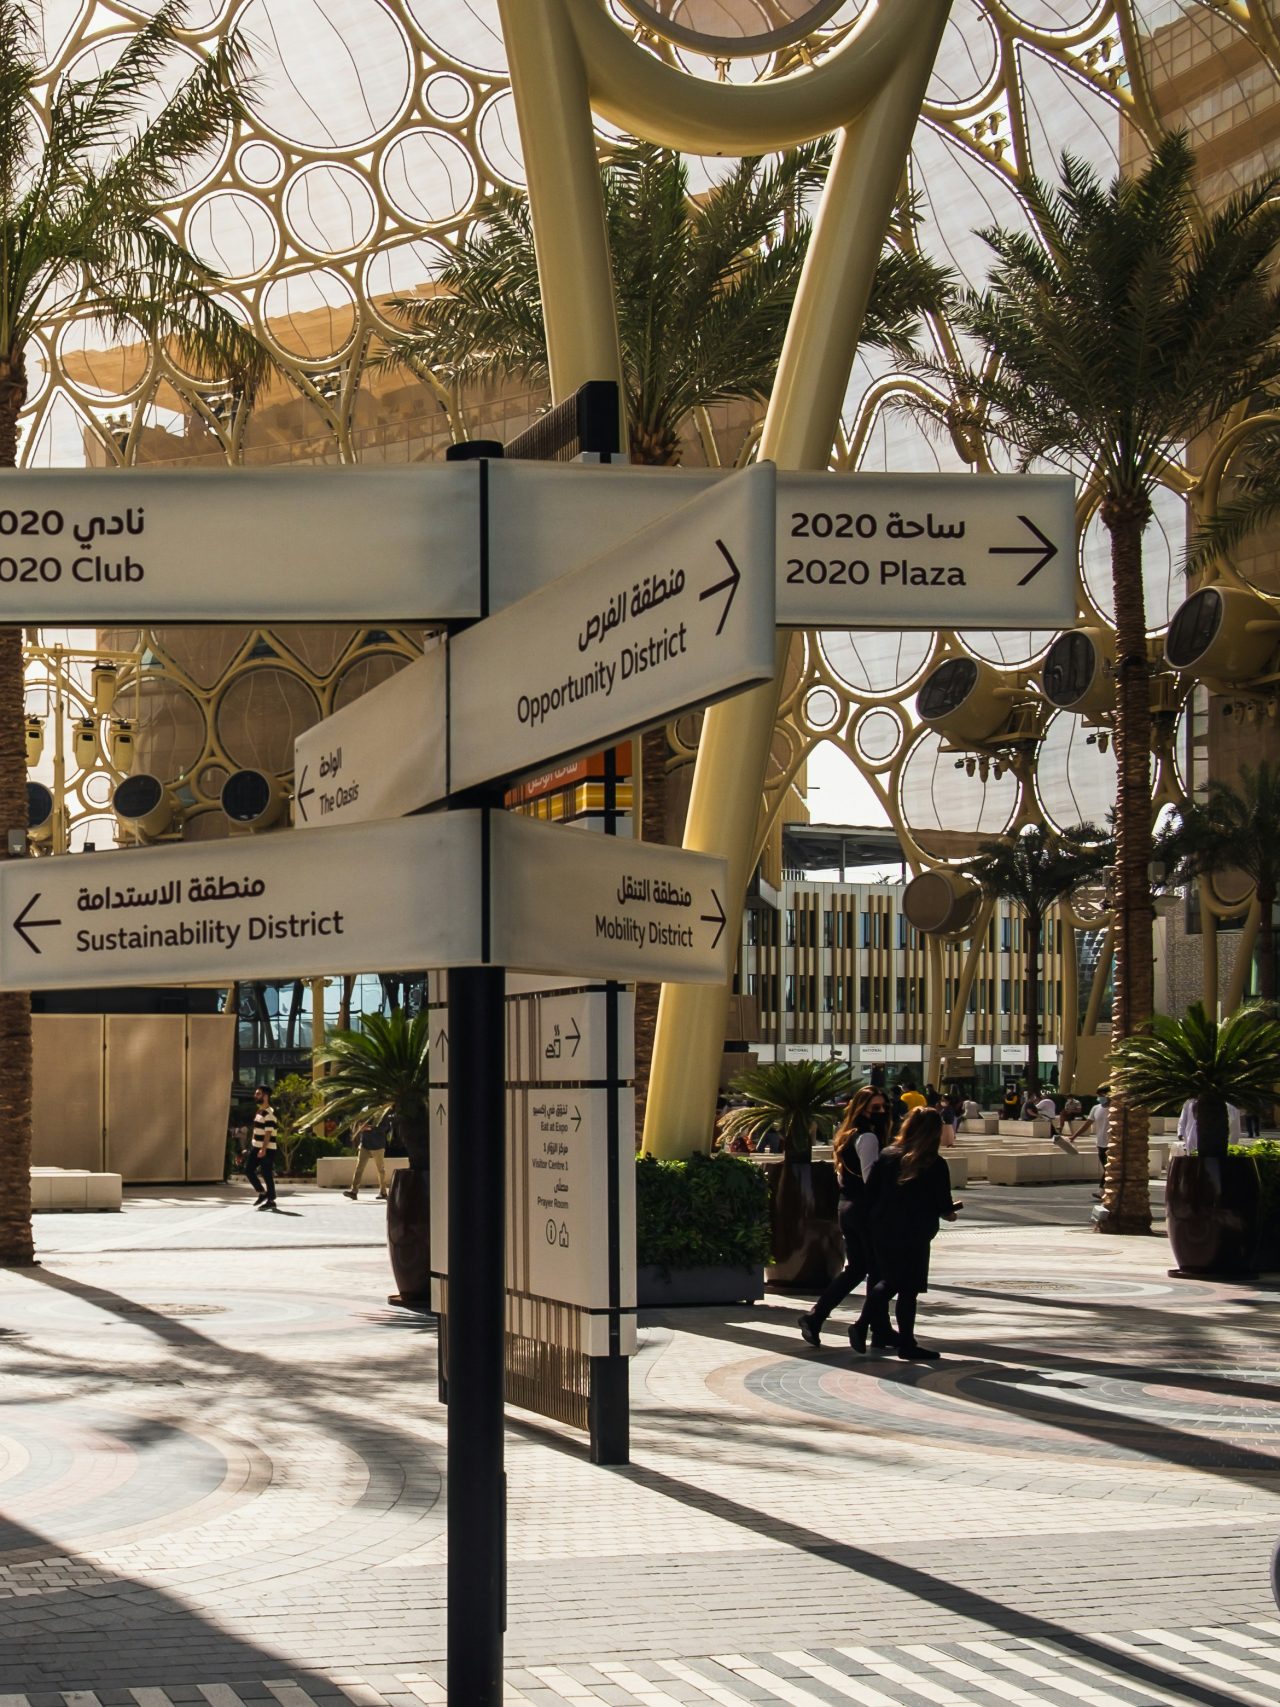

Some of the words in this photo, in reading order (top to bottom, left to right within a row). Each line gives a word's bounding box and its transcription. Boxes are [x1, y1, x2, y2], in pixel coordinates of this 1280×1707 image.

[73, 507, 144, 550] نادي
[791, 512, 877, 538] 2020
[886, 512, 965, 539] ساحة
[72, 555, 145, 582] Club
[786, 559, 870, 585] 2020
[880, 559, 966, 586] Plaza
[630, 569, 686, 618] منطقة
[578, 591, 626, 652] الفرص
[517, 661, 616, 728] Opportunity
[621, 622, 687, 680] District
[320, 747, 342, 778] الواحة
[320, 793, 335, 815] The
[336, 780, 359, 808] Oasis
[77, 880, 182, 911] الاستدامة
[188, 876, 266, 903] منطقة
[617, 875, 651, 905] التنقل
[653, 880, 692, 907] منطقة
[76, 919, 241, 952] Sustainability
[249, 910, 344, 941] District
[595, 914, 646, 949] Mobility
[649, 921, 694, 948] District
[541, 1121, 549, 1131] Eat
[556, 1121, 568, 1134] Expo
[532, 1158, 547, 1169] Visitor
[548, 1160, 564, 1170] Centre
[537, 1196, 553, 1209] Prayer
[554, 1198, 568, 1209] Room
